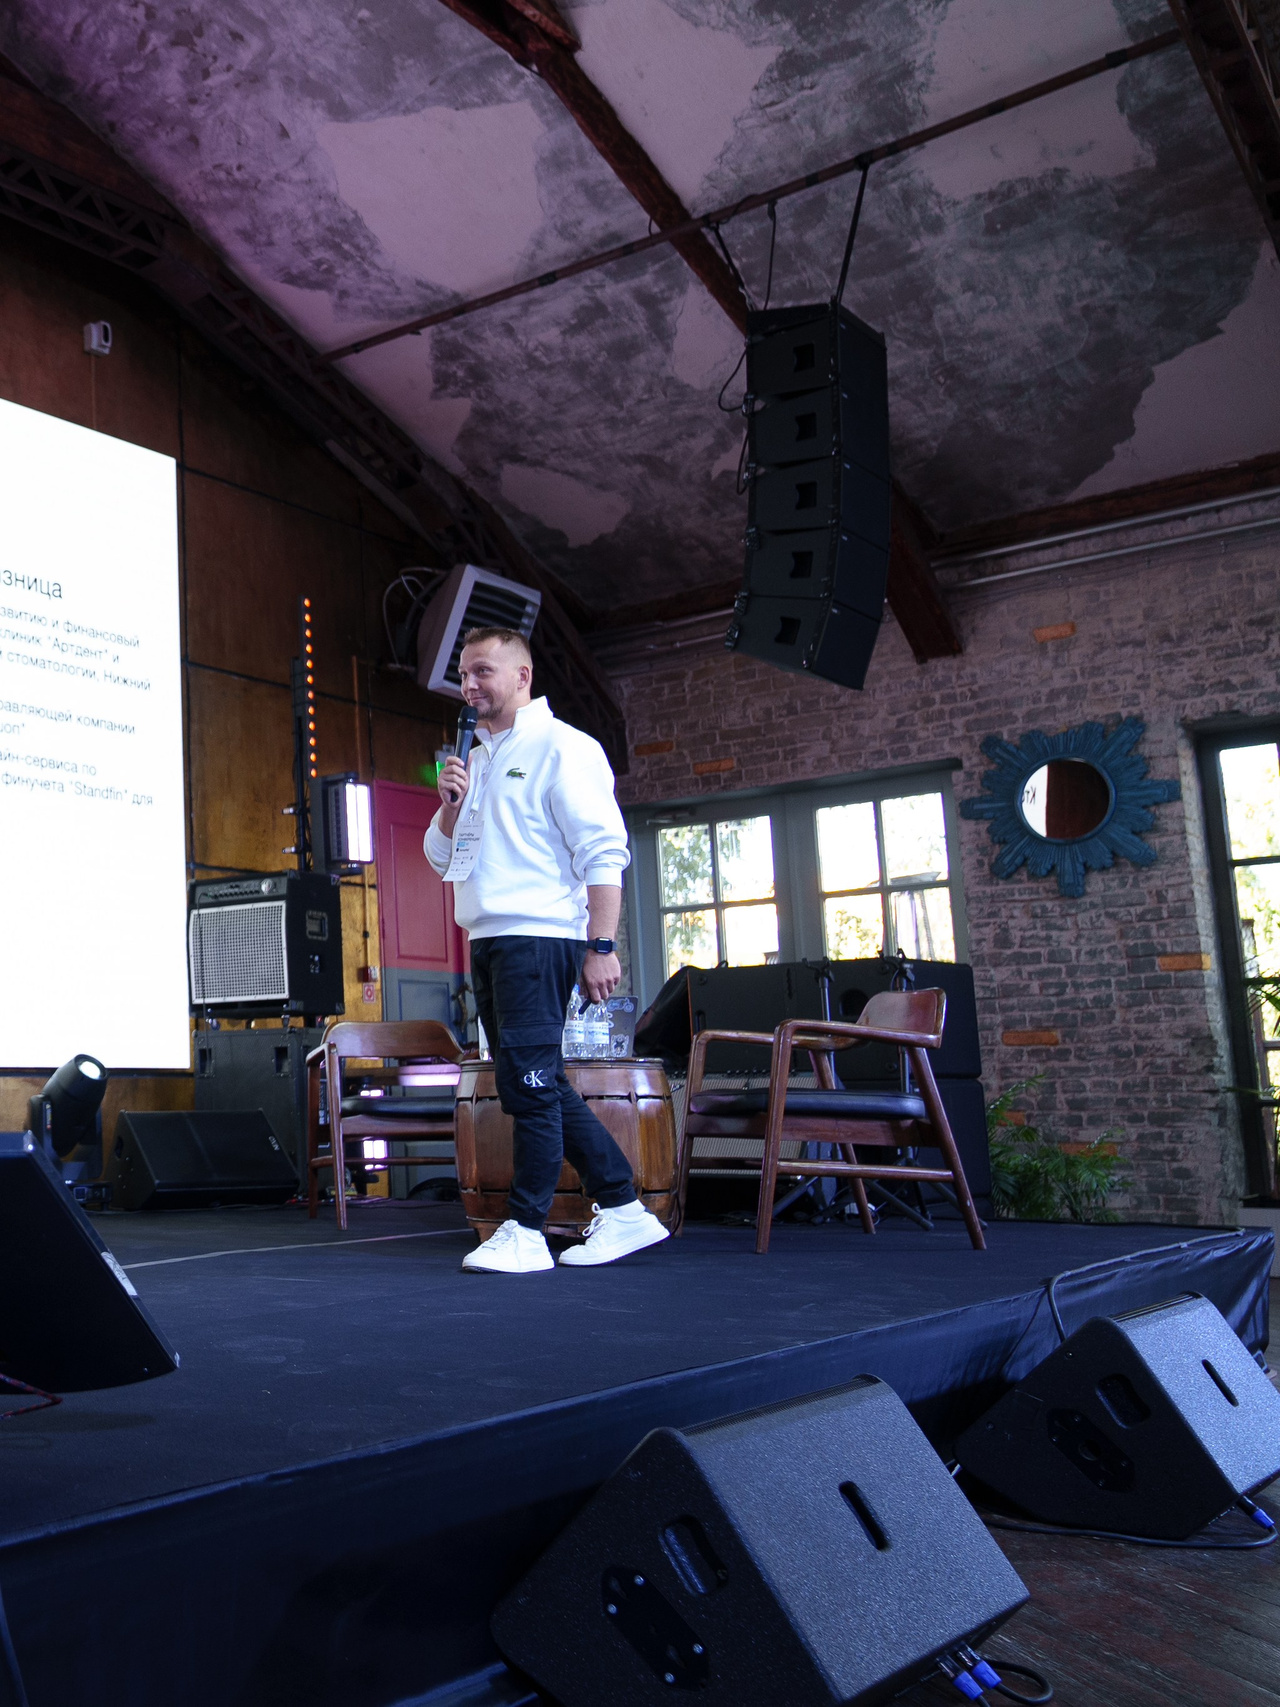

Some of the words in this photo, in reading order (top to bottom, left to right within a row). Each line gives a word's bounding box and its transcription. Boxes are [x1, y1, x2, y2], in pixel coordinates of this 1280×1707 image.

[51, 620, 58, 629] и
[63, 618, 140, 648] финансовый
[7, 650, 100, 682] стоматологии,
[103, 669, 151, 691] Нижний
[112, 655, 120, 664] и
[77, 714, 136, 735] компании
[82, 764, 97, 777] по
[1, 770, 65, 792] финучета
[131, 792, 153, 806] для
